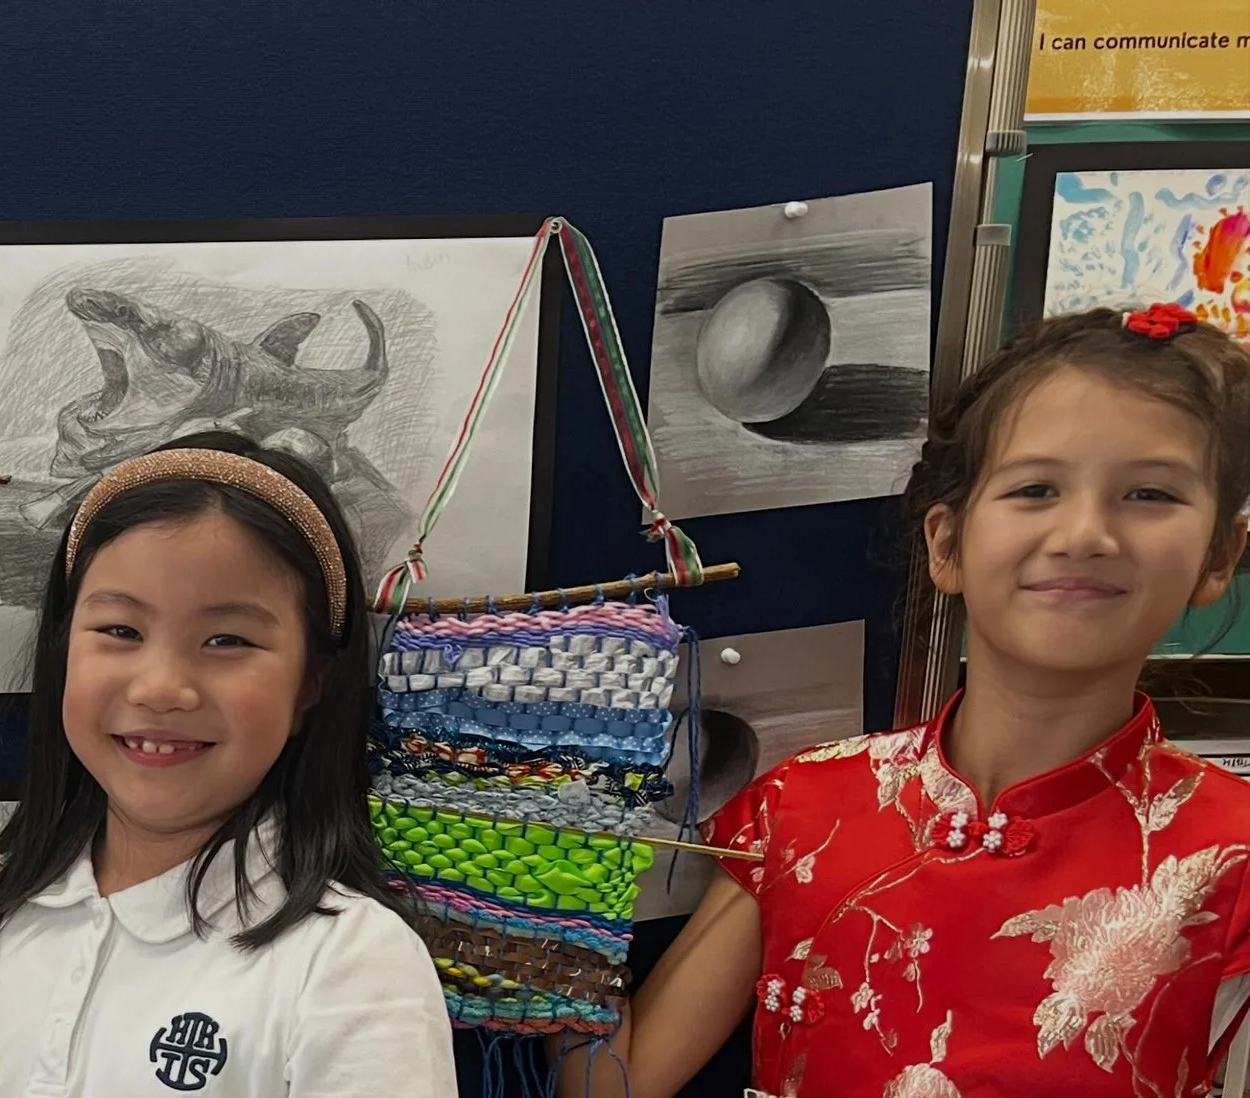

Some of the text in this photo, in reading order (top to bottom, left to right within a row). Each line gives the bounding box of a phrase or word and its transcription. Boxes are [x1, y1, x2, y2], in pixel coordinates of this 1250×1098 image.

[1039, 33, 1045, 50] I
[1052, 37, 1086, 50] can
[1094, 32, 1230, 49] communicate
